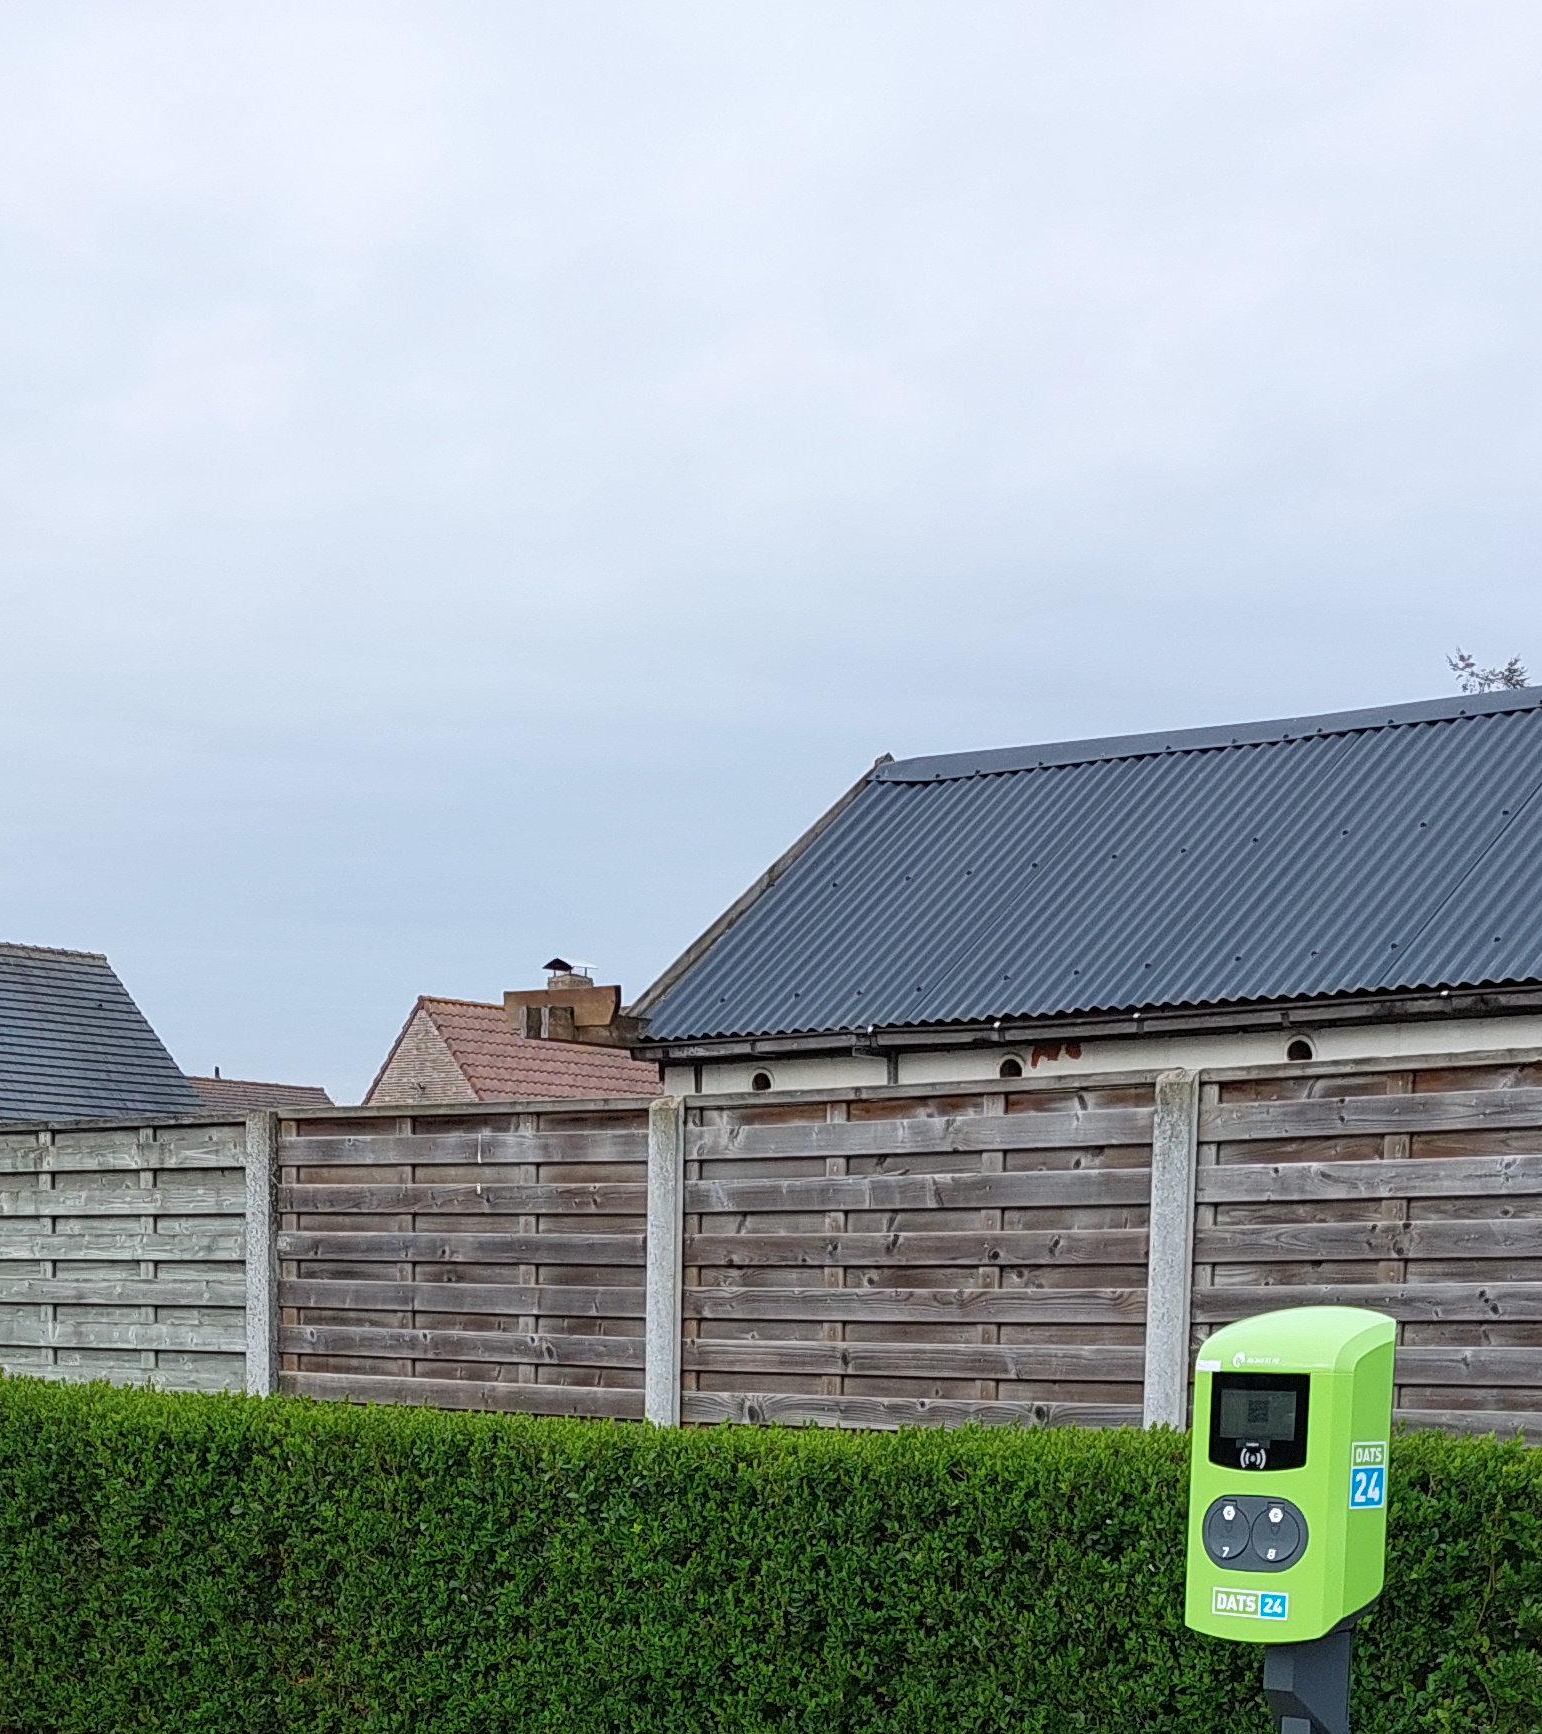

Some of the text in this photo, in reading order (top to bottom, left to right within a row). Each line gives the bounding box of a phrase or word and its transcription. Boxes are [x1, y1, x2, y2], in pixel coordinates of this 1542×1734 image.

[1355, 1447, 1382, 1463] DATS
[1354, 1471, 1380, 1503] 24
[1222, 1546, 1230, 1558] 7
[1266, 1548, 1276, 1560] 8
[1216, 1593, 1283, 1614] DATS 24
